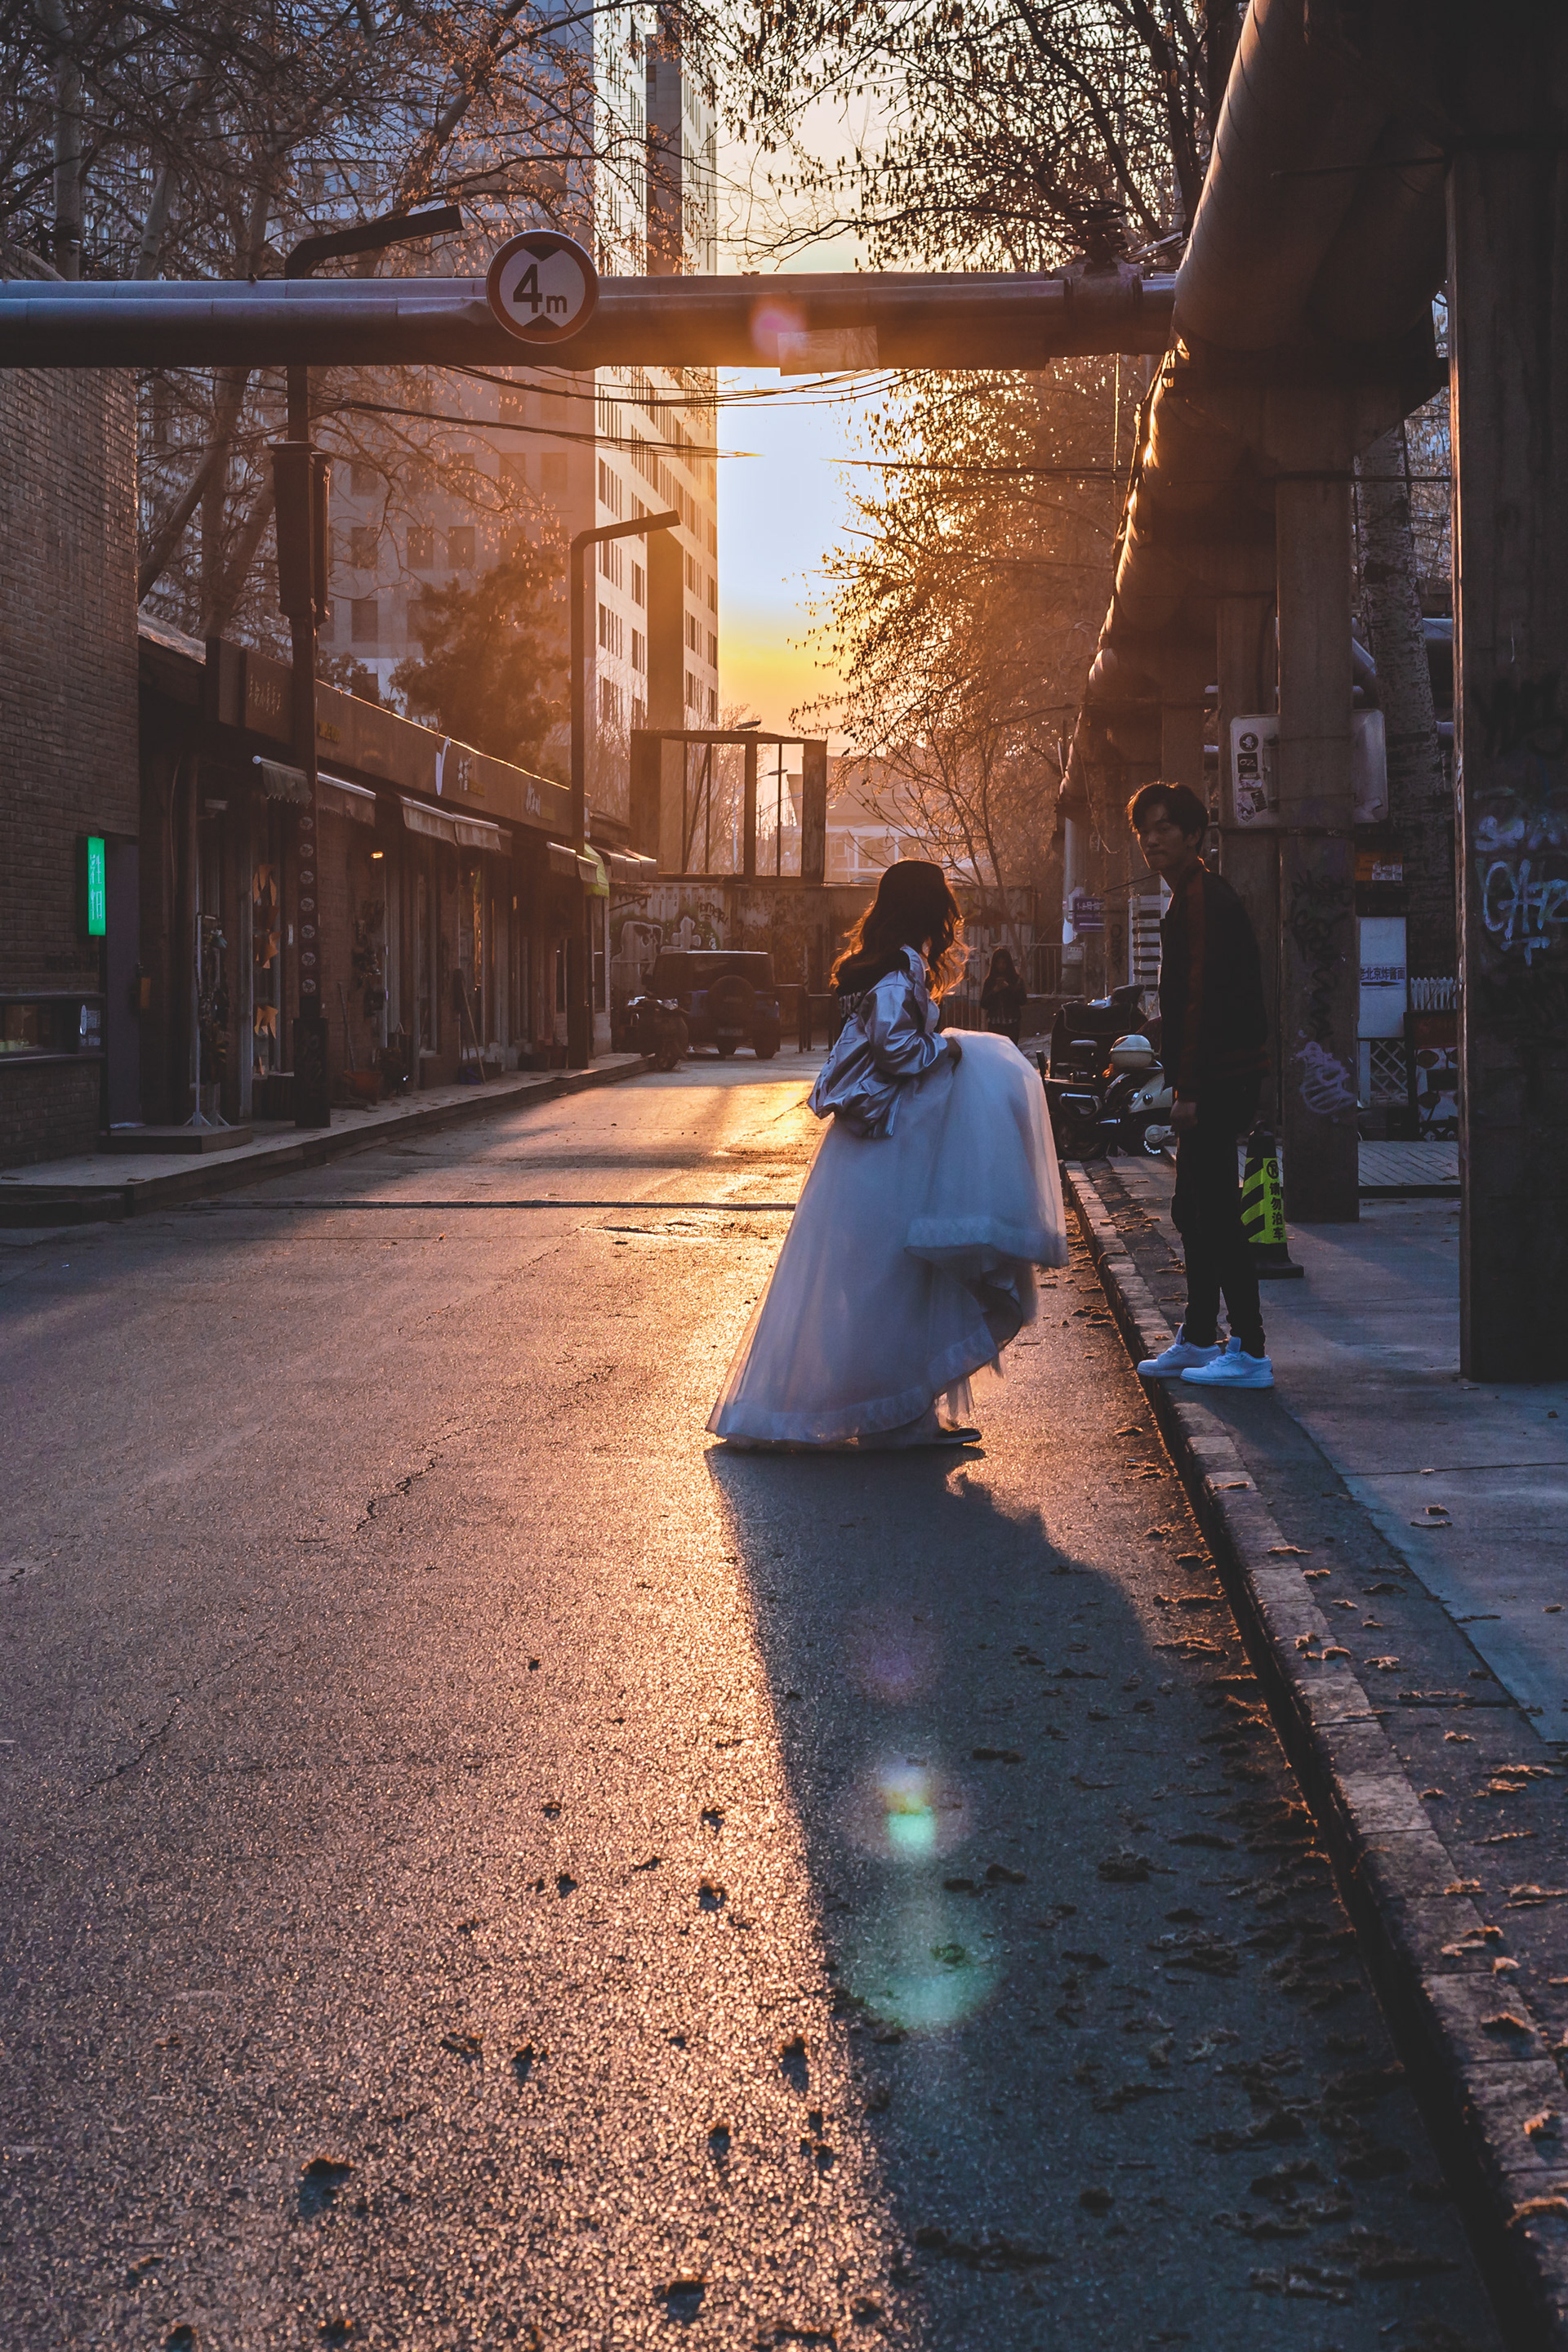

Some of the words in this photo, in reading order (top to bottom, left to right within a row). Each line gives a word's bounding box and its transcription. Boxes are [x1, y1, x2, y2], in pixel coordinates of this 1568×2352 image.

[513, 264, 568, 314] 4m
[1270, 1182, 1284, 1241] 请勿泊车
